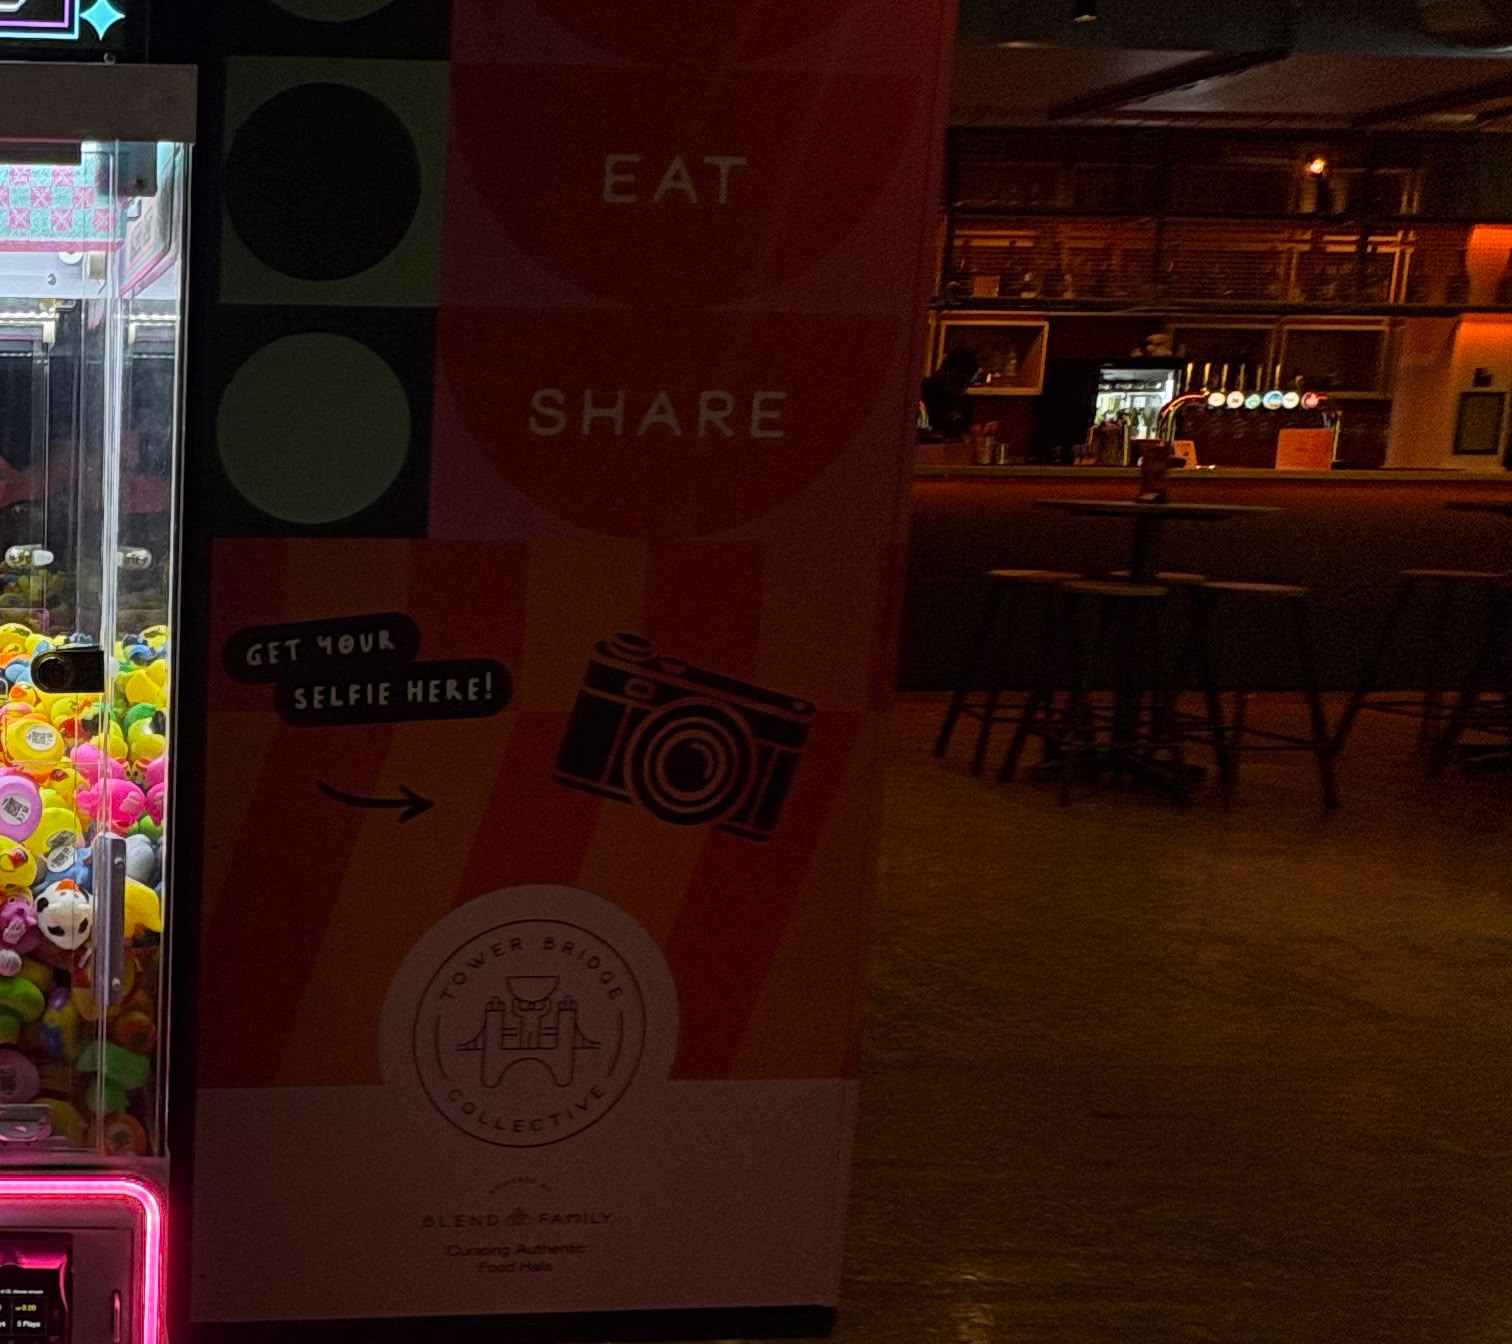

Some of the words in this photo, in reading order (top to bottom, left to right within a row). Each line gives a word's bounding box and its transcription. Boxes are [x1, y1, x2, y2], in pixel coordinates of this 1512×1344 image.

[602, 153, 747, 205] EAT
[527, 388, 788, 439] SHARE
[246, 638, 303, 667] GET
[315, 628, 396, 656] YOUR
[293, 682, 392, 710] SELFIE
[407, 671, 493, 703] HERE!
[439, 937, 525, 1000] TOWER
[543, 936, 624, 1001] BRIDGE
[447, 1085, 605, 1133] COLLECTIVE
[422, 1214, 499, 1227] BLEND
[538, 1211, 614, 1225] FAMILY
